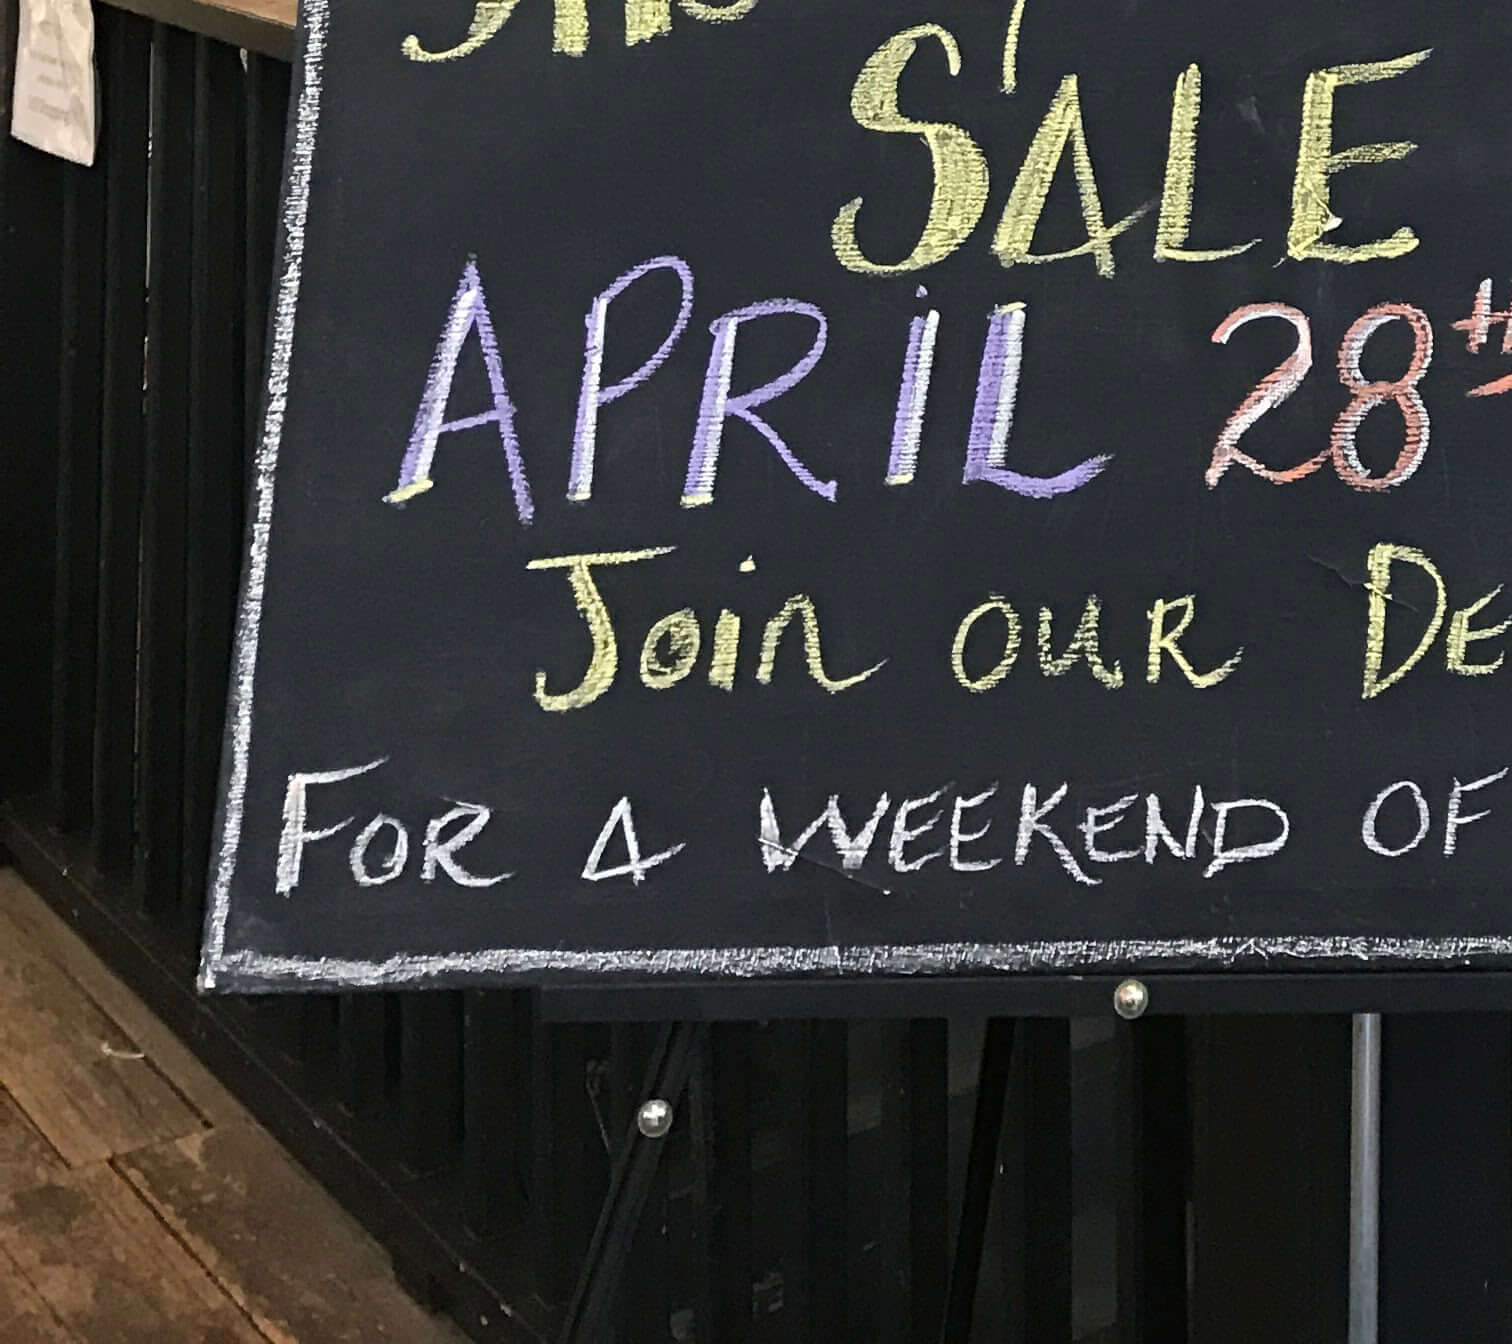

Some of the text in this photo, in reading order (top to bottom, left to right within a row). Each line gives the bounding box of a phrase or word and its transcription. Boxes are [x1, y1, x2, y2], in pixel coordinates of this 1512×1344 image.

[831, 23, 1434, 278] SALE
[274, 756, 517, 897] FOR
[580, 794, 687, 887] A
[757, 780, 1291, 887] WEEKEND
[1362, 766, 1509, 861] OF
